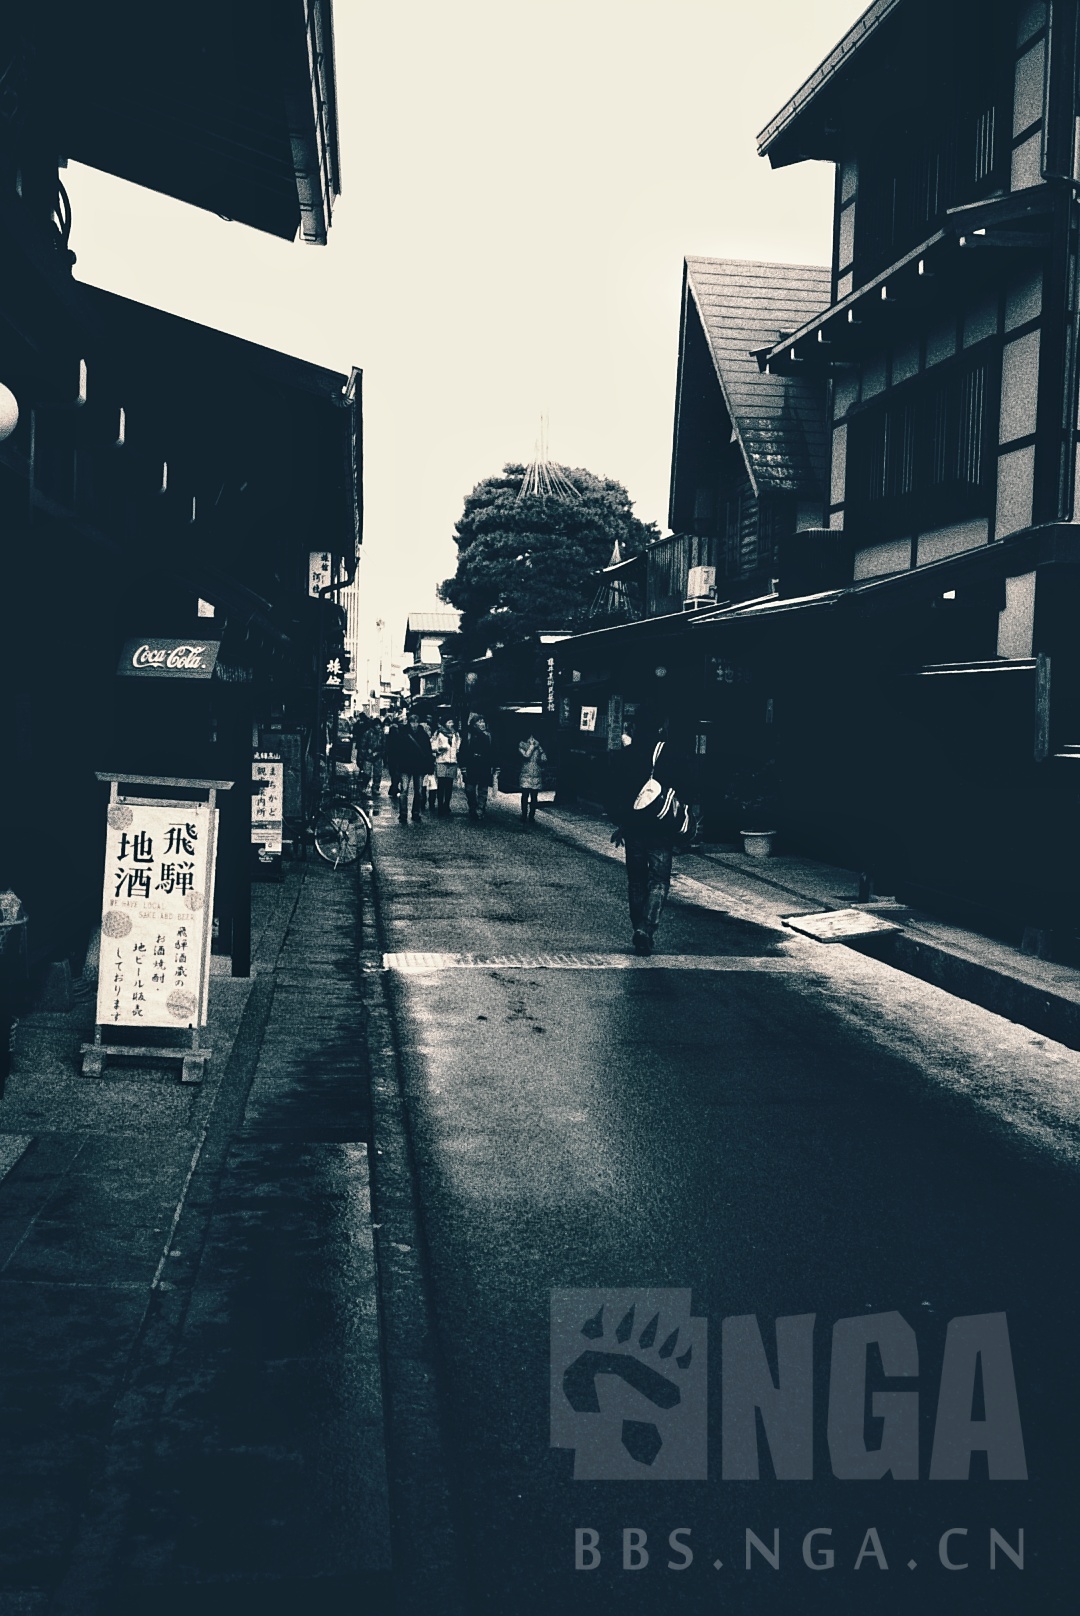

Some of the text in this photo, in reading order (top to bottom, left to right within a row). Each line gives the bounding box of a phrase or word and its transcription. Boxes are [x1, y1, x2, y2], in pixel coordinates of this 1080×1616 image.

[256, 766, 267, 817] 観案内所
[268, 766, 277, 817] まちかど
[114, 830, 155, 899] 地酒
[155, 822, 198, 896] 飛騨
